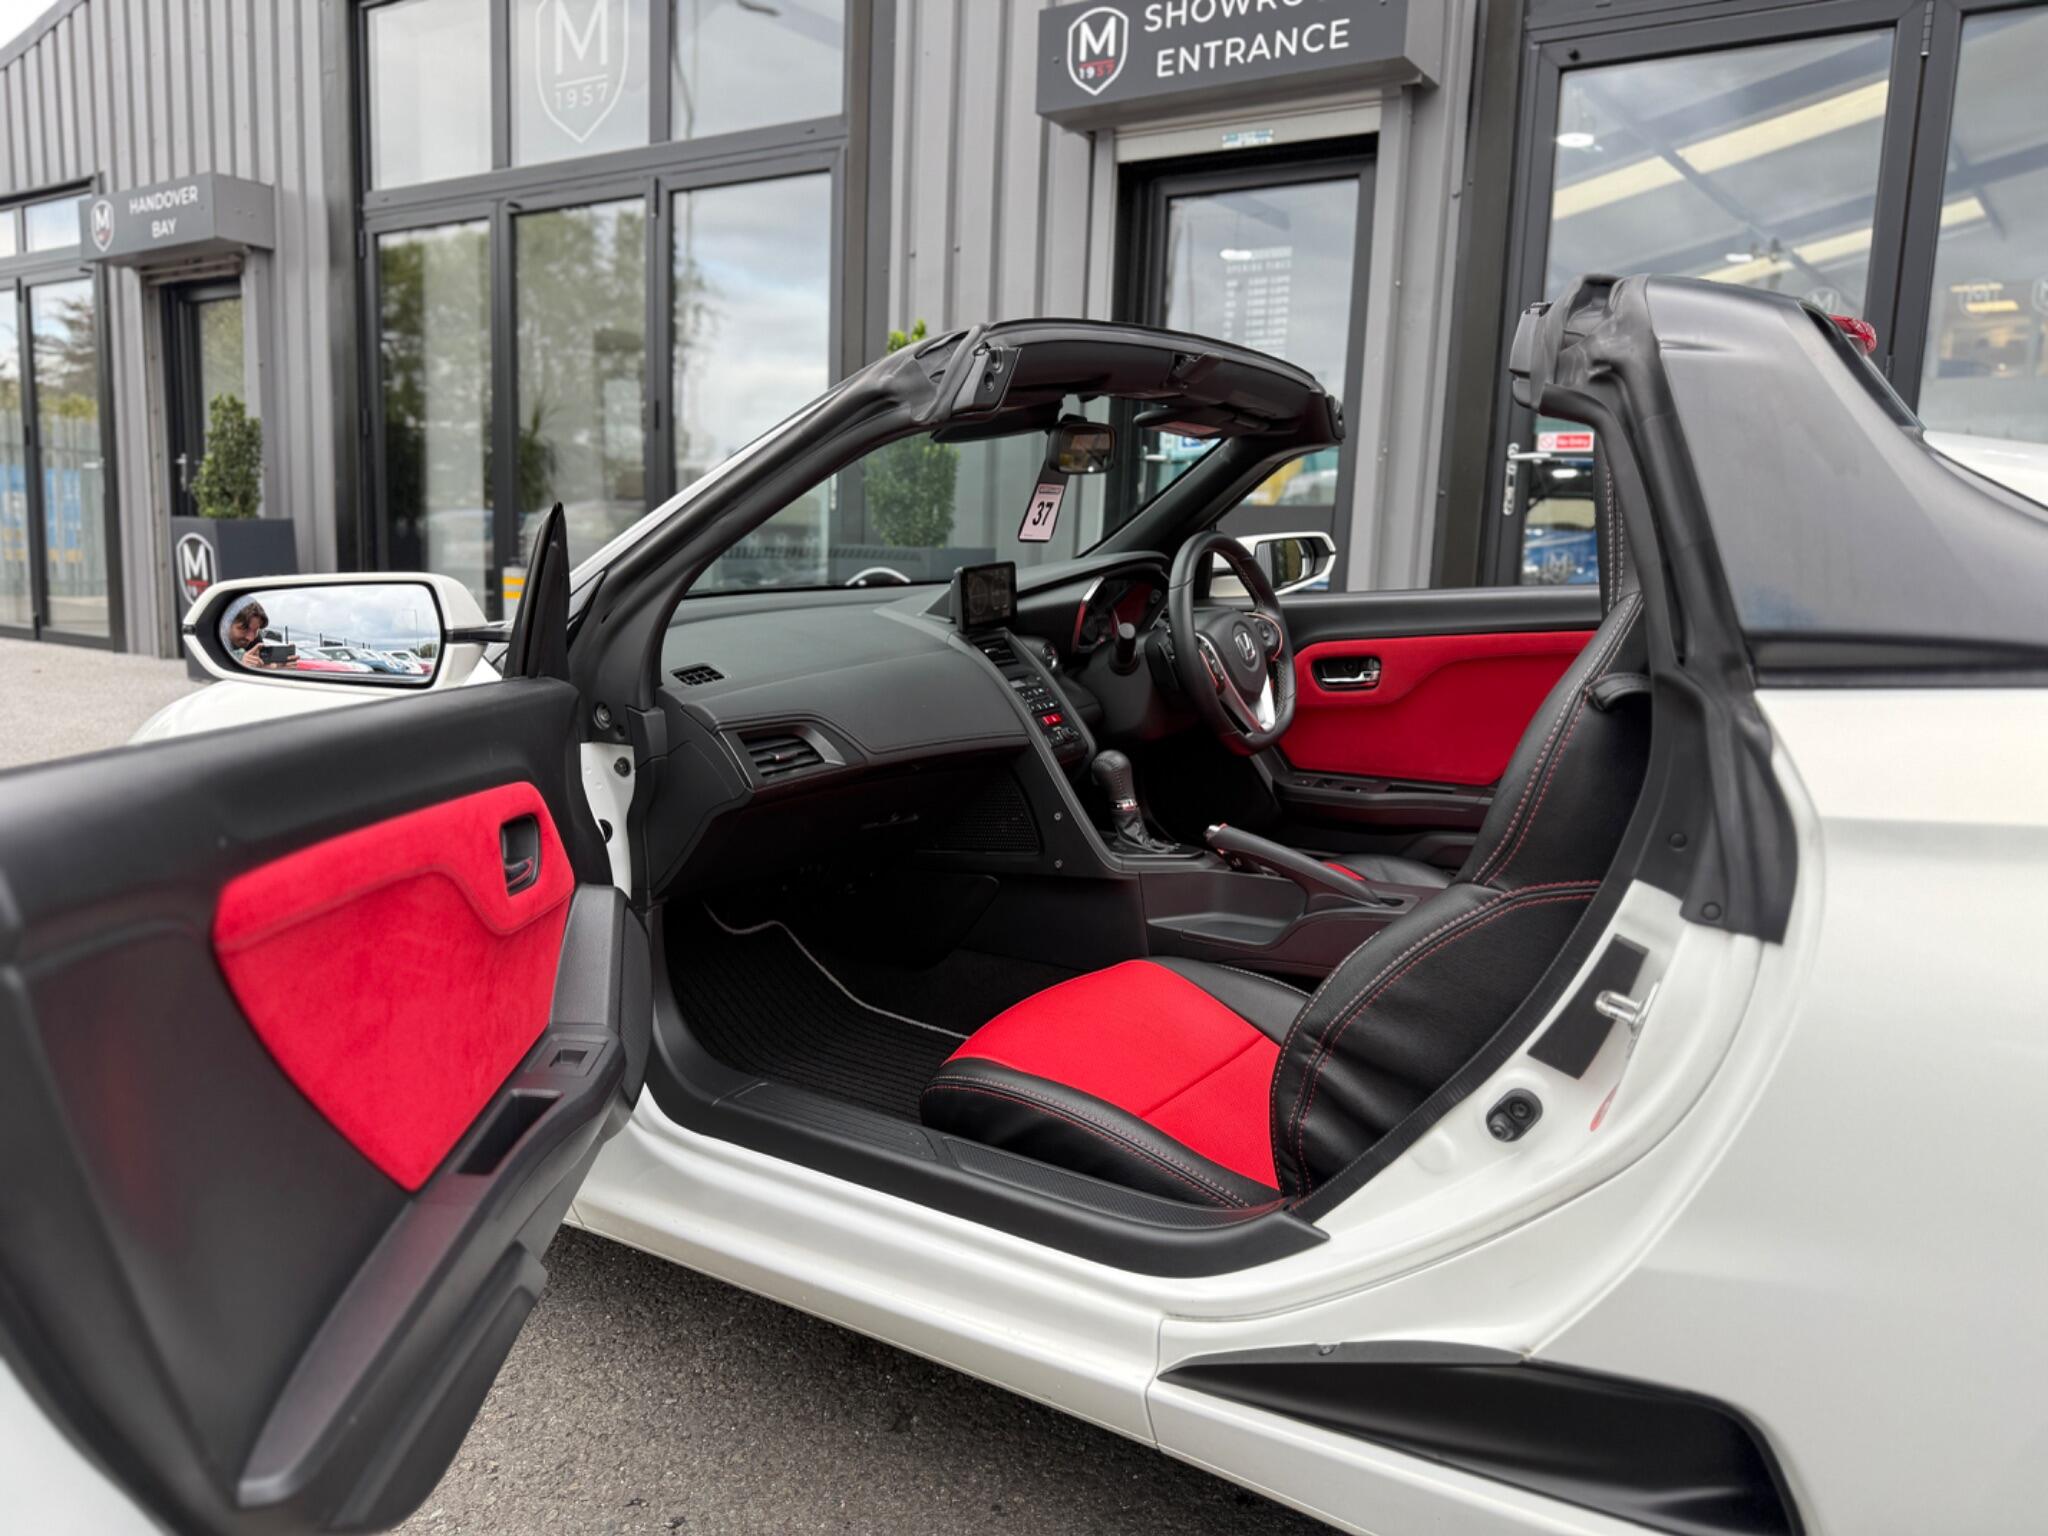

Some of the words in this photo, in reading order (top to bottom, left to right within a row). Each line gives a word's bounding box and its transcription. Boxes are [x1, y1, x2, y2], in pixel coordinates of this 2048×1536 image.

[555, 0, 608, 75] M
[1079, 15, 1116, 62] M
[1157, 18, 1350, 77] ENTRANCE
[555, 82, 608, 112] 1957
[129, 185, 198, 214] HANDOVER
[96, 207, 110, 231] M
[151, 218, 177, 239] BAY
[1032, 500, 1055, 526] 37
[183, 542, 208, 581] M
